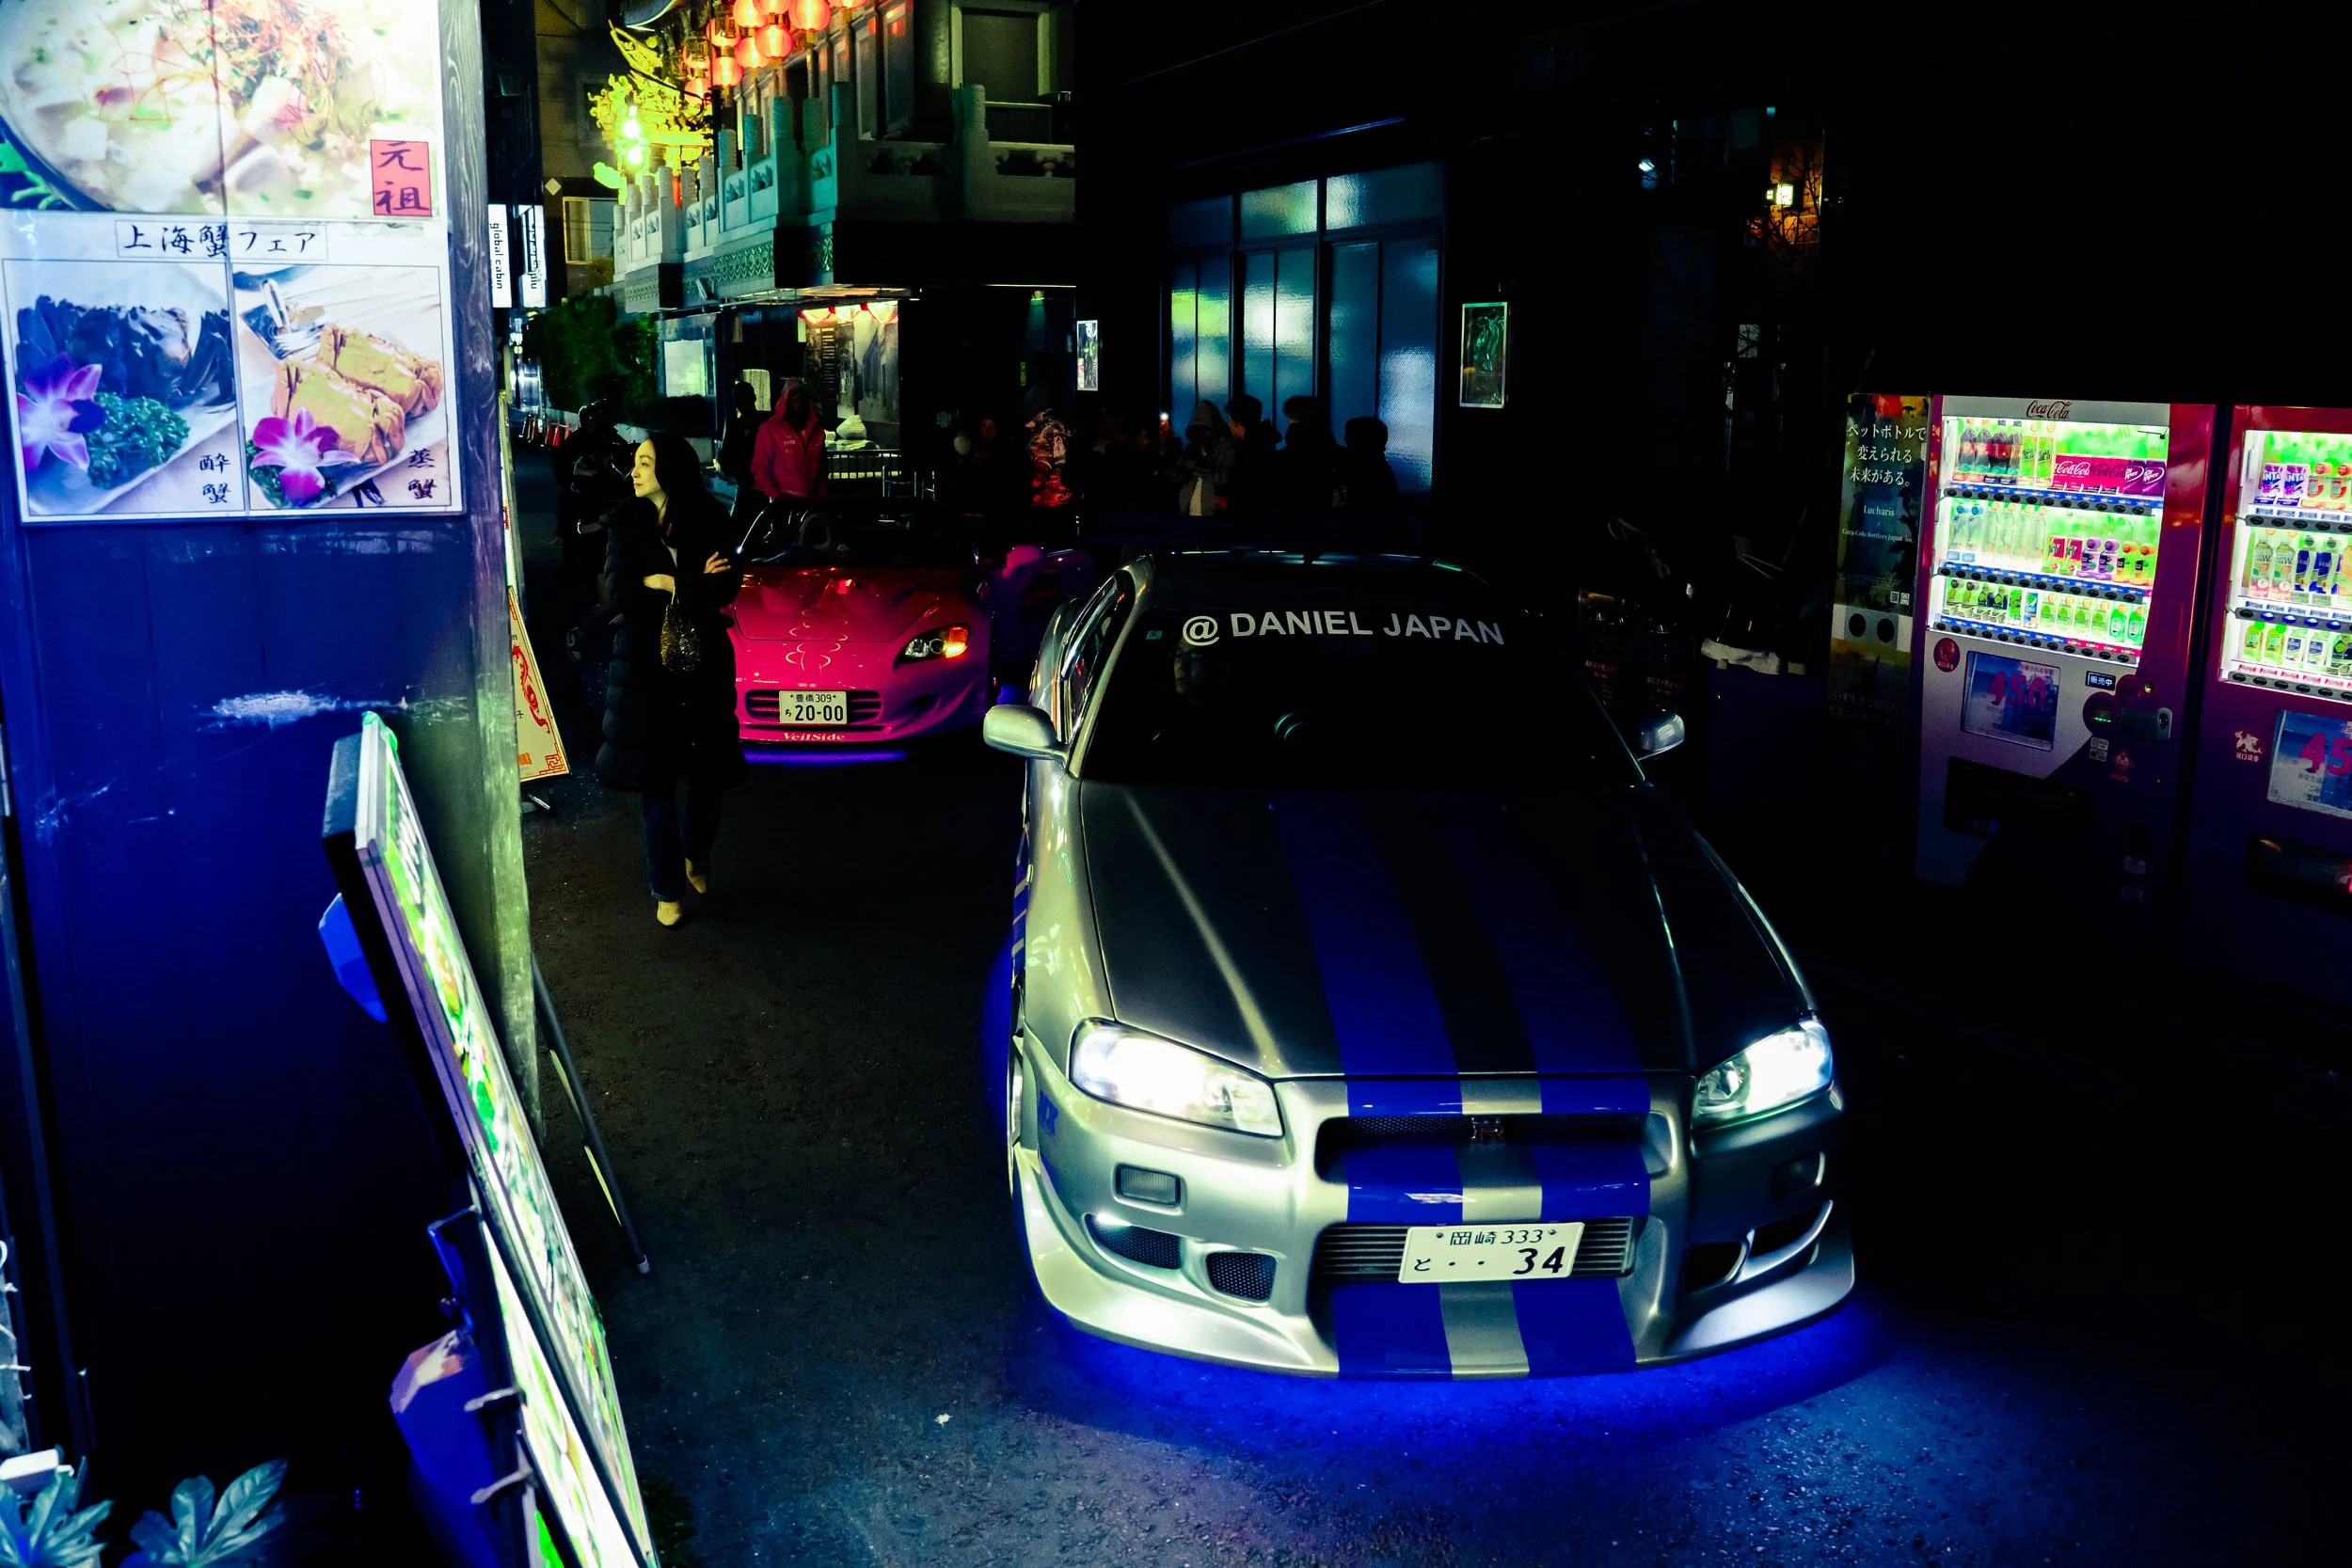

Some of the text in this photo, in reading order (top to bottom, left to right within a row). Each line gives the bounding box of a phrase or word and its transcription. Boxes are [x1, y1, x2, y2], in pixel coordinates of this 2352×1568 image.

[375, 141, 432, 214] 元祖
[124, 224, 316, 258] 上海蟹フェア
[489, 223, 505, 289] global cabin
[2026, 400, 2073, 420] Coca-Cola
[1848, 424, 1927, 441] ペットボトルで
[1857, 444, 1913, 463] 変えられる
[1850, 466, 1911, 487] 未来がある。
[1864, 504, 1895, 516] Lucharis
[1182, 610, 1505, 647] @ DANIEL JAPAN
[2090, 675, 2113, 687] 販売中
[795, 705, 843, 721] 20-00
[783, 732, 846, 741] VeilSide
[1413, 1257, 1432, 1272] と
[1512, 1245, 1566, 1275] 34
